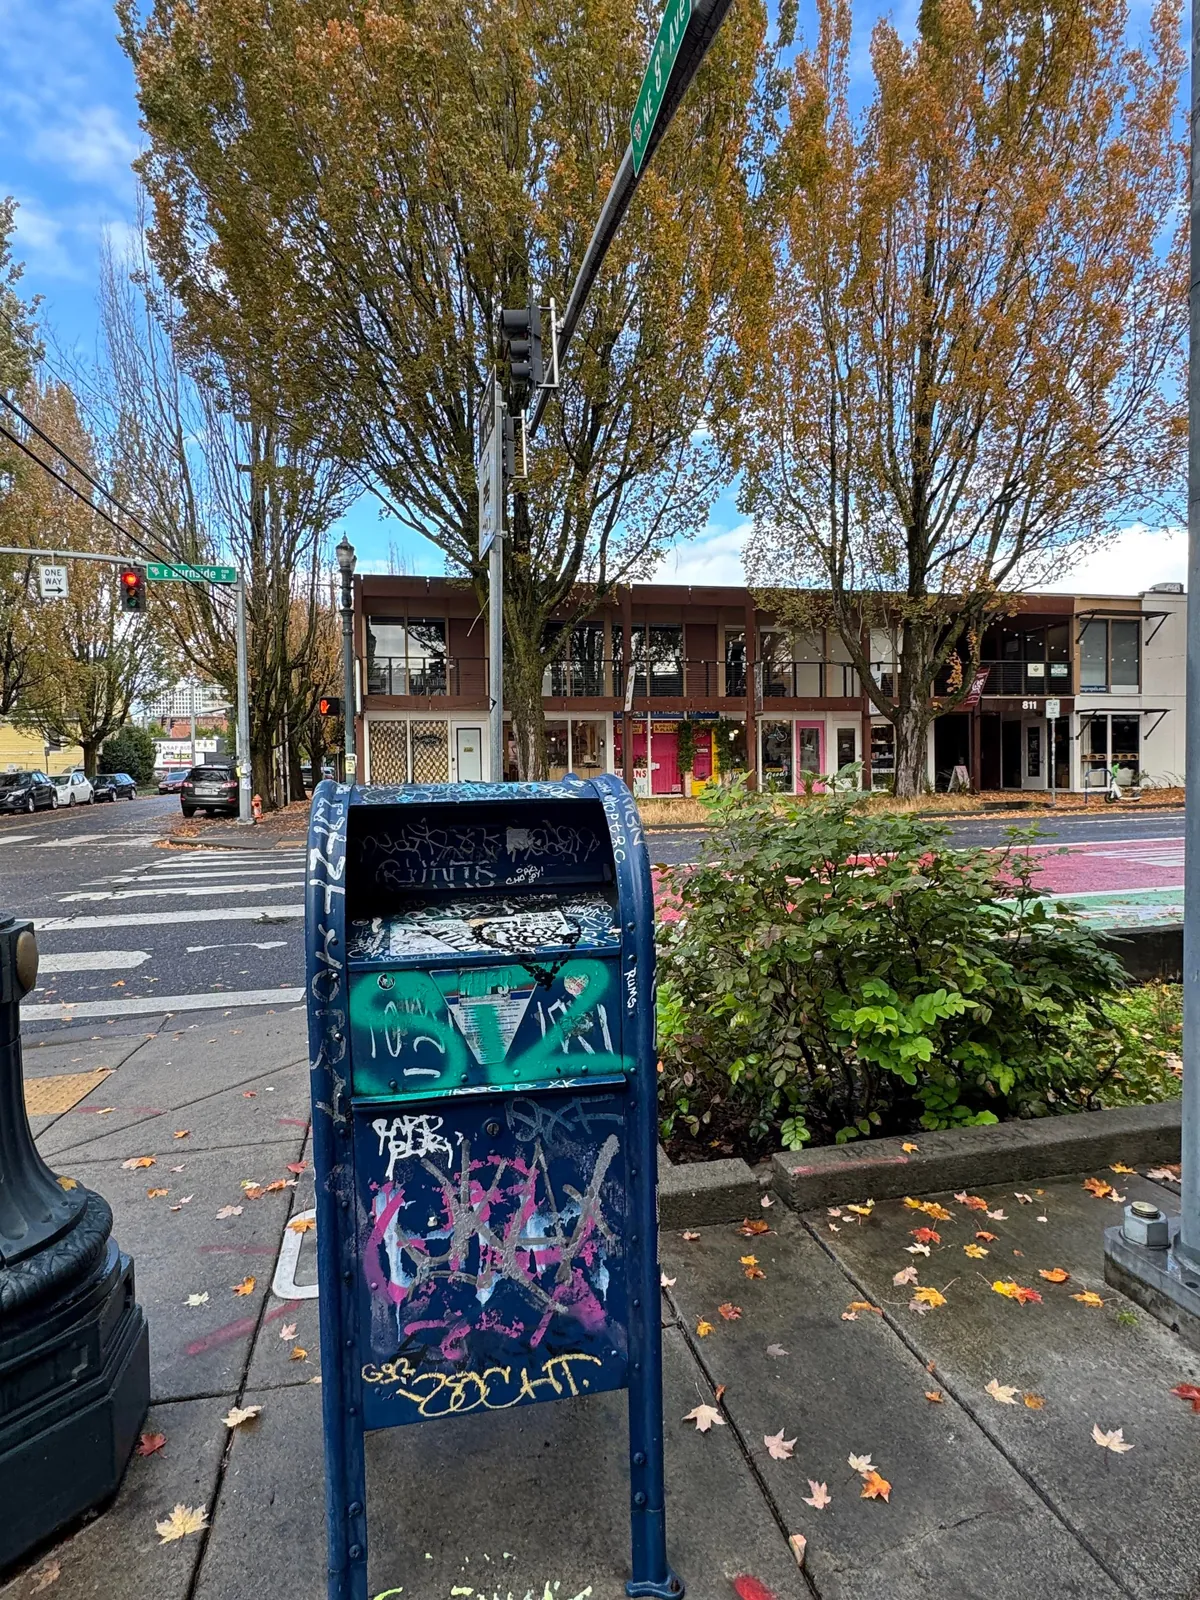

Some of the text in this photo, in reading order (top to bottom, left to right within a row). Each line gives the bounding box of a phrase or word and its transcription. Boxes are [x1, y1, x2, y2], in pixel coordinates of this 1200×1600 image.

[642, 89, 653, 131] NE
[44, 568, 63, 577] ONE
[172, 567, 217, 579] Burnside
[1021, 700, 1038, 710] 811
[613, 769, 647, 778] HUNS
